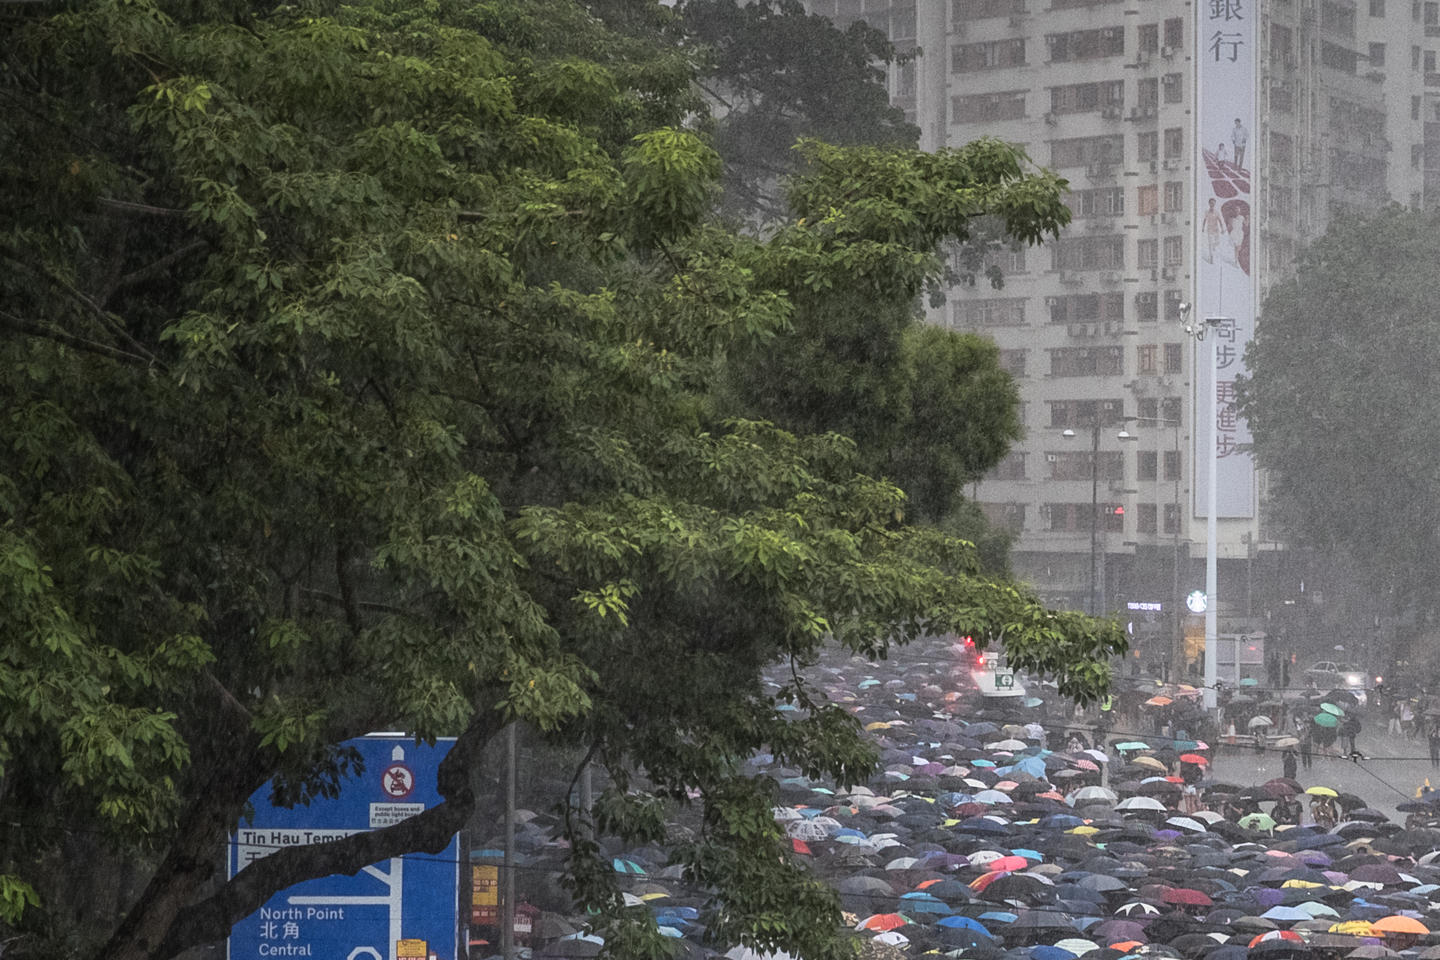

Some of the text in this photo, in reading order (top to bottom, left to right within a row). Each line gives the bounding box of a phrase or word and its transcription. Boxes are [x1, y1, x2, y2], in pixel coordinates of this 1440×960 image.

[1208, 0, 1244, 62] 銀行
[243, 832, 266, 845] Tin
[271, 832, 300, 845] Hau
[260, 907, 345, 920] North Point
[260, 921, 300, 939] 北角
[258, 943, 312, 956] Central
